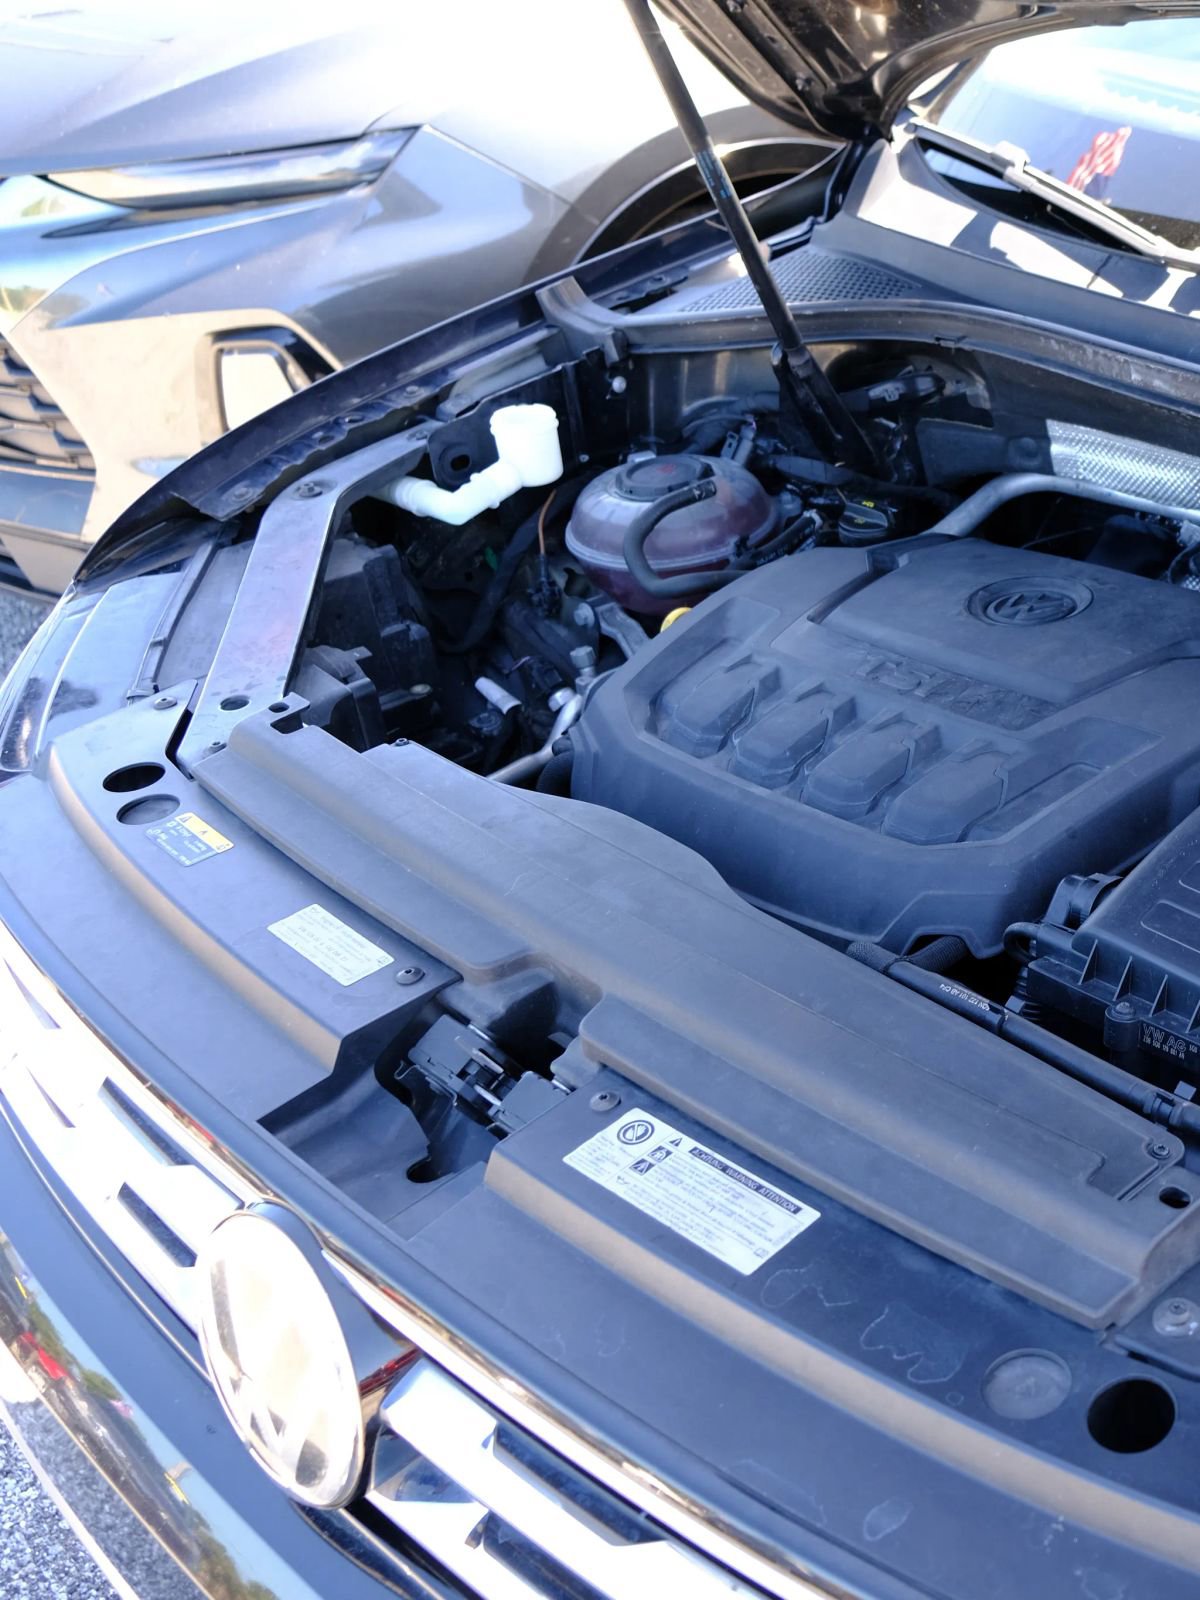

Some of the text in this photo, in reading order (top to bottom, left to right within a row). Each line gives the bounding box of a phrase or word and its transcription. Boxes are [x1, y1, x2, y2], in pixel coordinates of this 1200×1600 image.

[1142, 1023, 1186, 1052] VW AG
[692, 1147, 798, 1213] ACHTUNG WARNING ATTENTION
